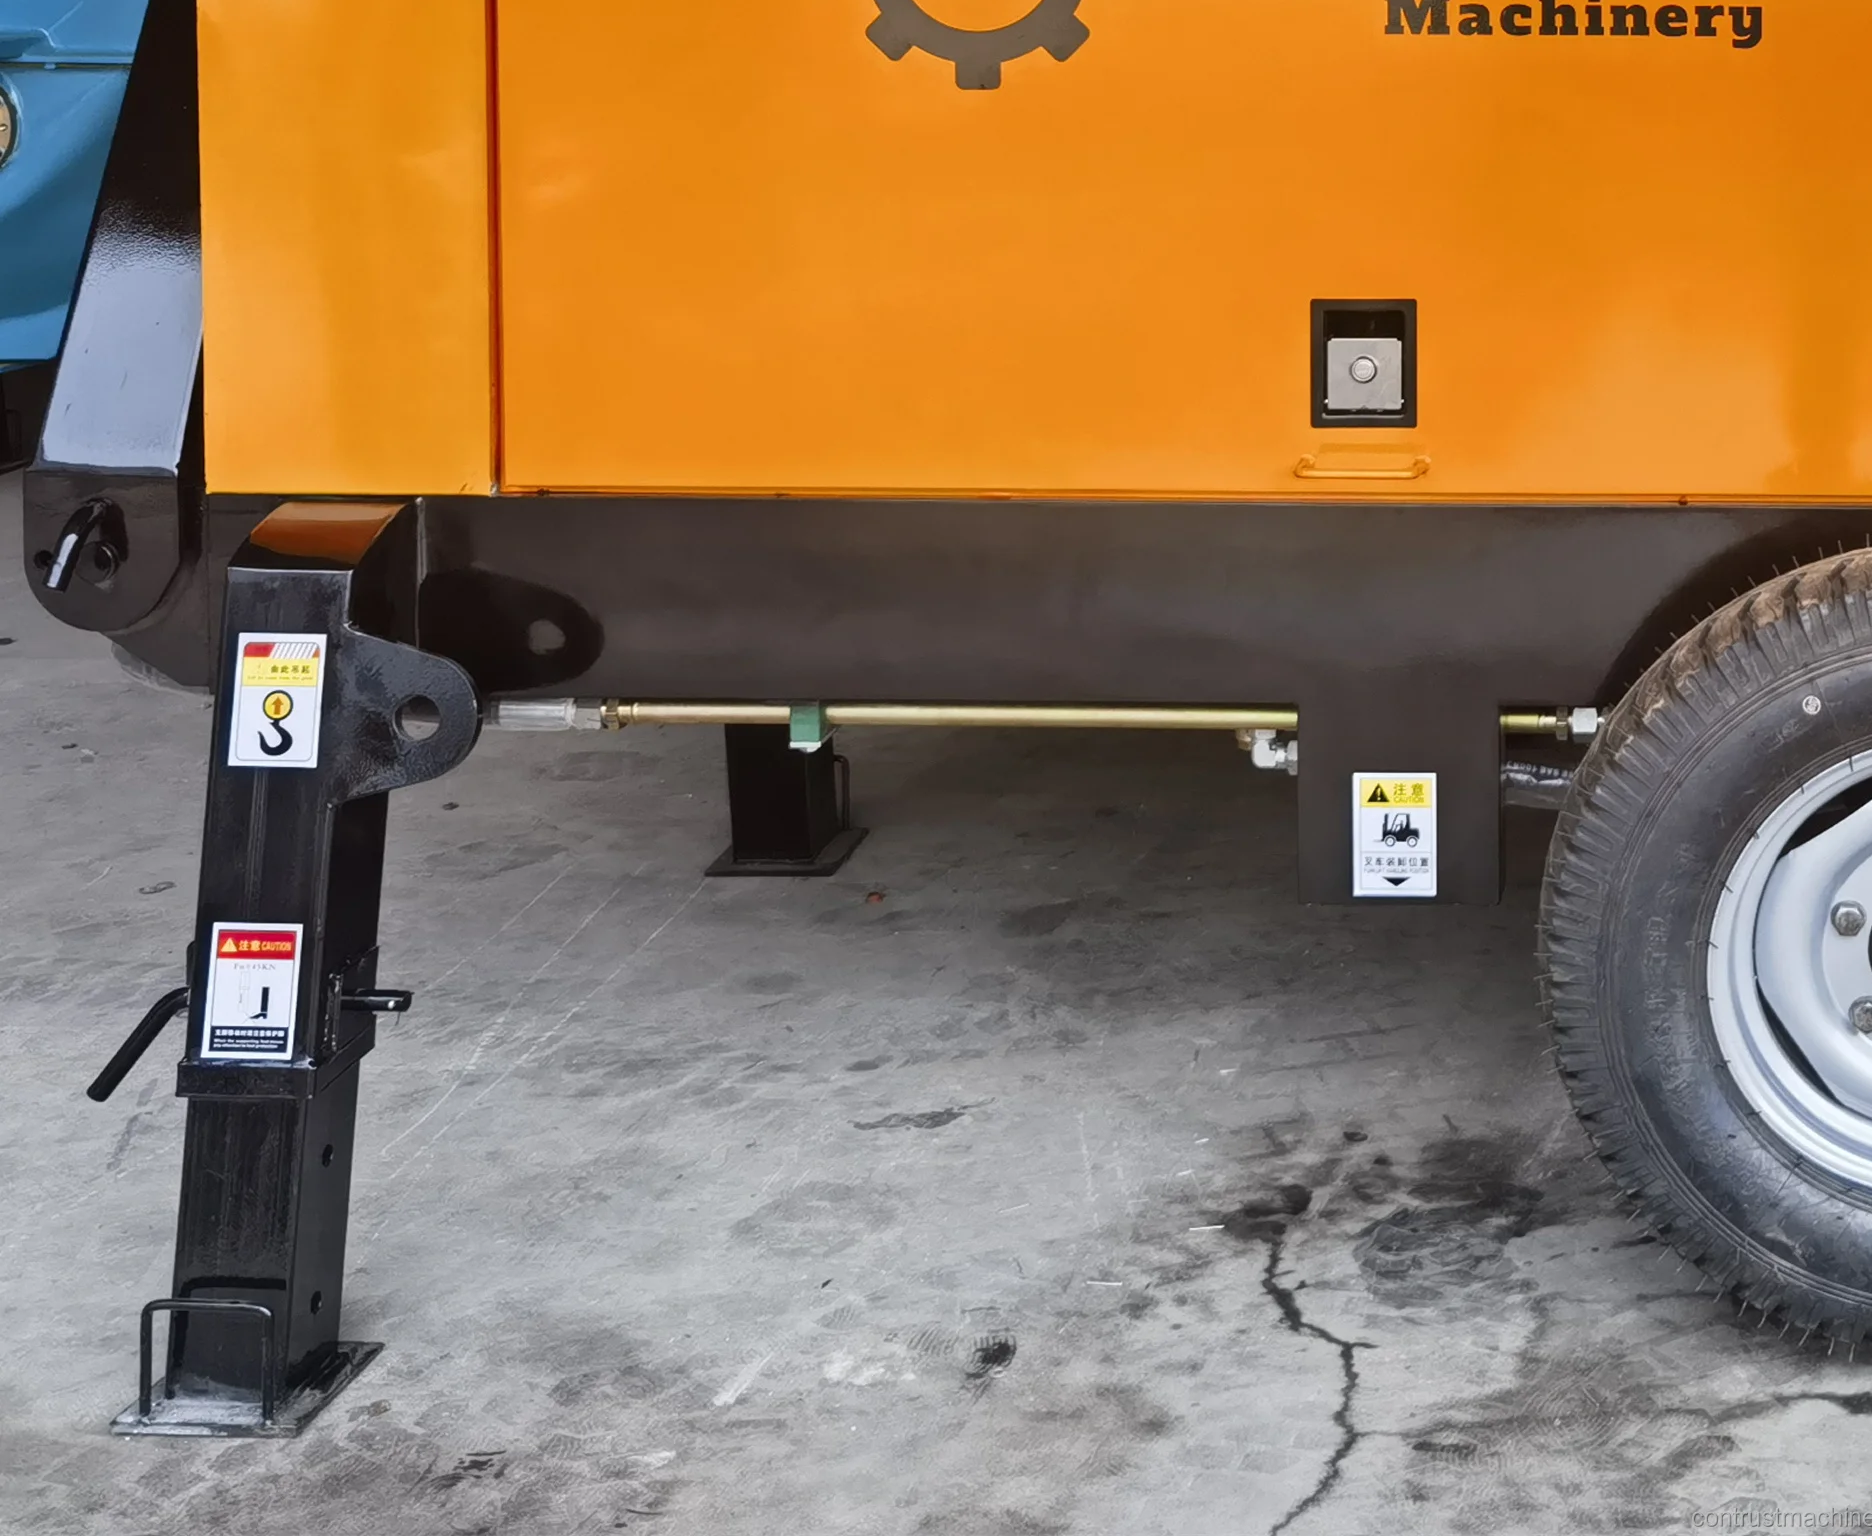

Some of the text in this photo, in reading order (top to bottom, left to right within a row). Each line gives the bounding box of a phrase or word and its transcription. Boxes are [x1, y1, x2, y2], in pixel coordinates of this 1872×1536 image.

[1393, 783, 1424, 796] 注意
[1364, 856, 1429, 867] 叉车装卸位置
[238, 940, 292, 951] 注意 CAUTION
